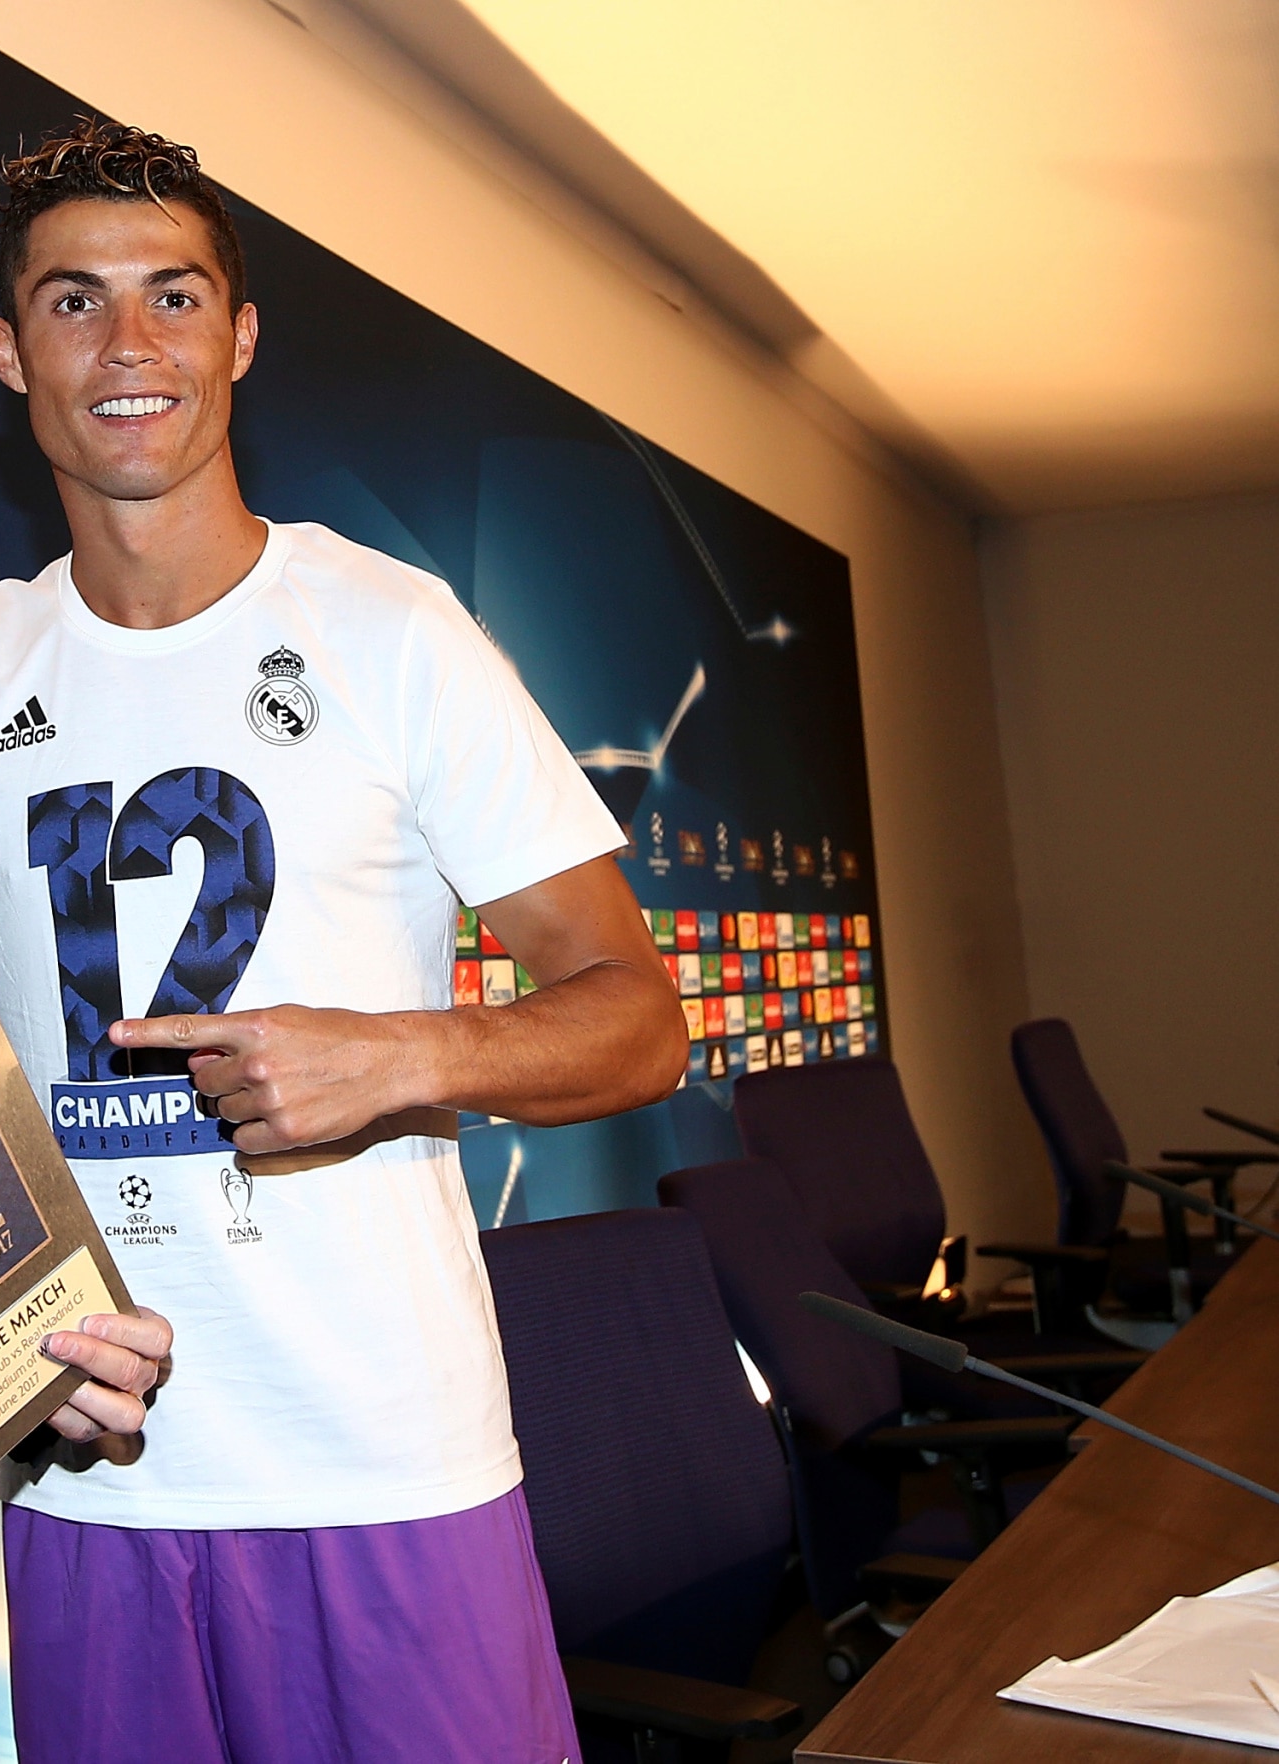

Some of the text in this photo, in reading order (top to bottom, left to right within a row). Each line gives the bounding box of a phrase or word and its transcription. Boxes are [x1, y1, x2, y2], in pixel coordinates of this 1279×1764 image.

[27, 766, 276, 1081] 12
[55, 1090, 221, 1129] CHAMPI
[104, 1225, 178, 1236] CHAMPIONS
[226, 1226, 262, 1239] FINAL
[9, 1278, 67, 1336] MATCH
[11, 1345, 23, 1358] vs
[21, 1327, 43, 1350] Real
[42, 1300, 74, 1333] Madrid
[73, 1289, 86, 1305] CF
[26, 1352, 38, 1368] of
[19, 1371, 41, 1397] 2017
